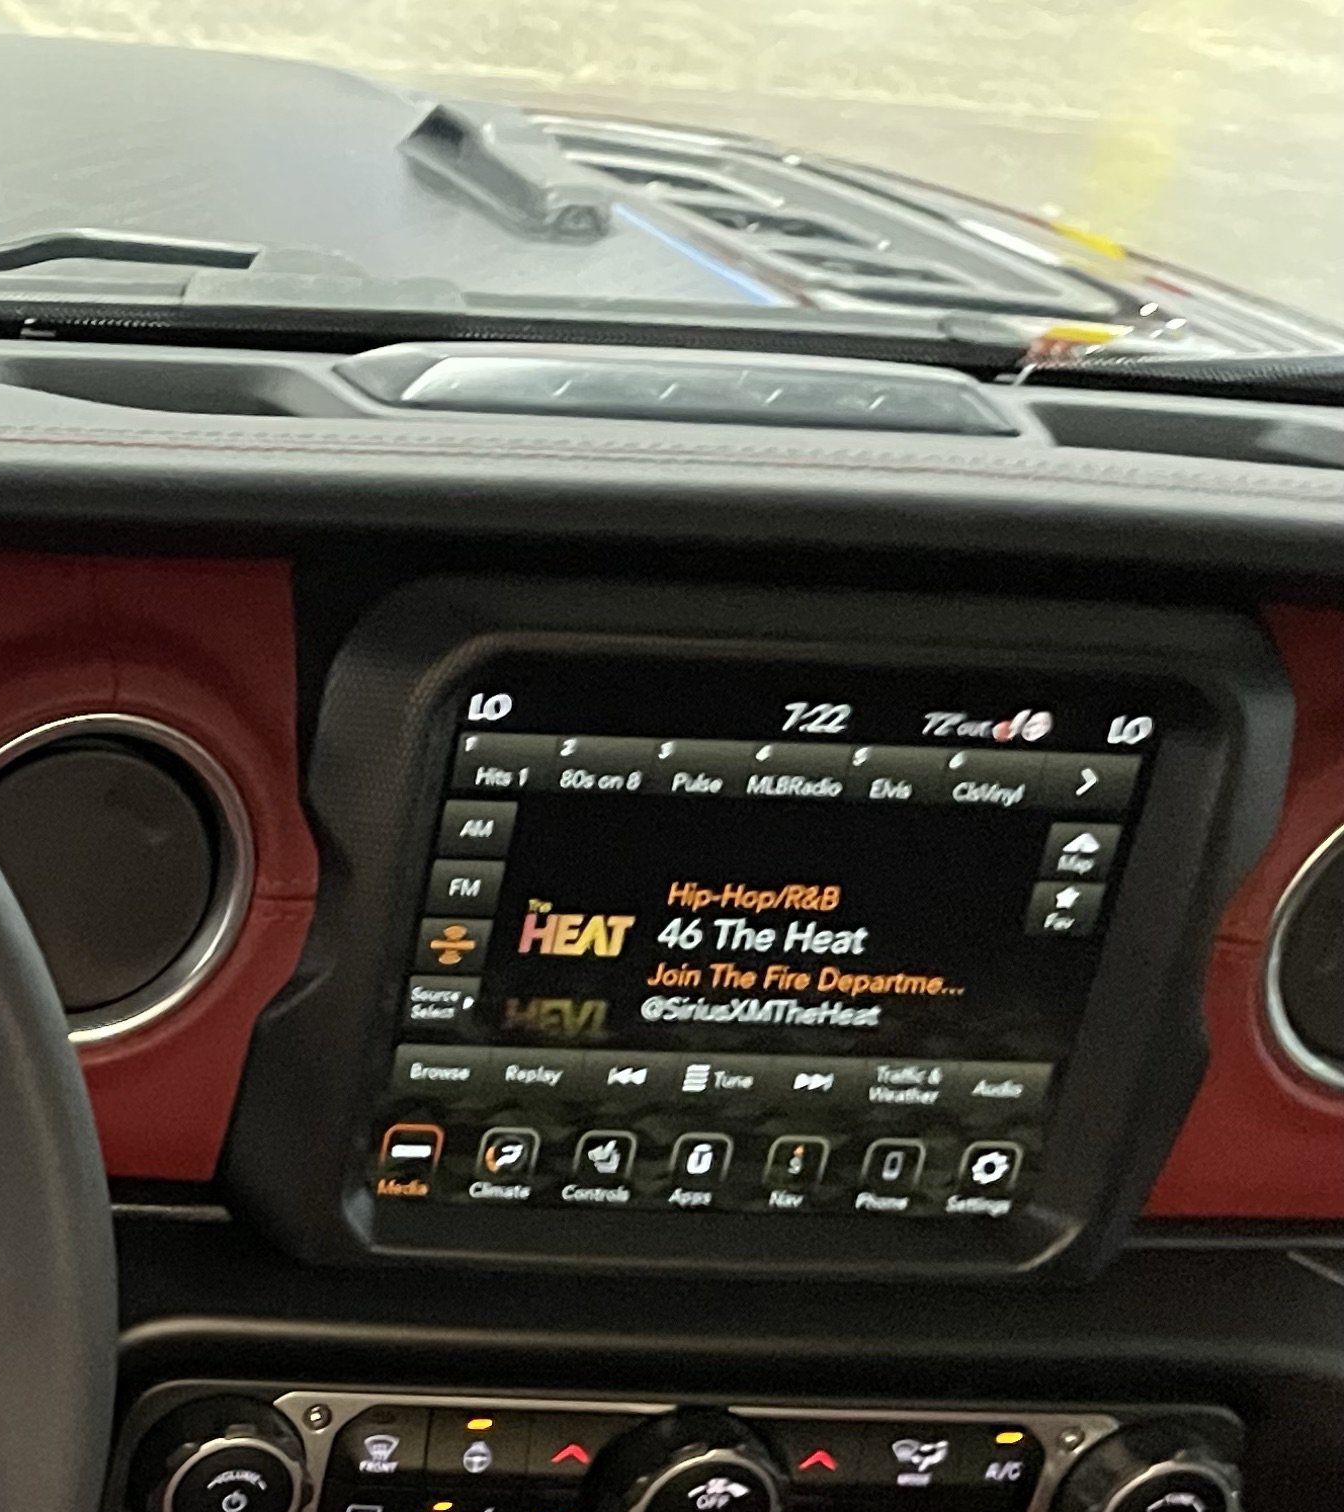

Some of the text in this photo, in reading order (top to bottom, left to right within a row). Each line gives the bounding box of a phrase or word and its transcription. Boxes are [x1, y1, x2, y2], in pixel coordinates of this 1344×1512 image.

[468, 693, 512, 721] LO
[781, 701, 853, 734] 7:22
[1107, 715, 1153, 745] LO
[465, 736, 478, 752] 1
[560, 738, 578, 756] 2
[475, 767, 531, 787] Hits 1
[559, 769, 643, 791] 80s on 8
[672, 772, 723, 794] Pulse
[746, 774, 843, 798] MLBRadio
[869, 778, 912, 800] Elvis
[460, 819, 495, 837] AM
[448, 878, 482, 897] FM
[666, 880, 841, 914] Hip-Hop/R&B
[518, 914, 636, 957] HEAT
[657, 917, 869, 956] 46 The Heat
[646, 963, 966, 997] Join The Fire Departme...
[410, 985, 461, 1002] Source
[640, 995, 883, 1026] @SiriusXMTheHeat
[410, 1061, 471, 1080] Browse
[504, 1064, 563, 1087] Replay
[714, 1070, 754, 1090] Tune
[869, 1086, 940, 1104] Weather
[971, 1079, 1024, 1099] Audio
[376, 1178, 430, 1196] Media
[469, 1181, 531, 1200] Climate
[562, 1184, 630, 1202] Controls
[668, 1188, 712, 1207] Apps
[769, 1190, 804, 1208] Nav
[359, 1460, 399, 1473] FRONT
[985, 1460, 1024, 1482] A/C
[696, 1493, 731, 1511] OFF
